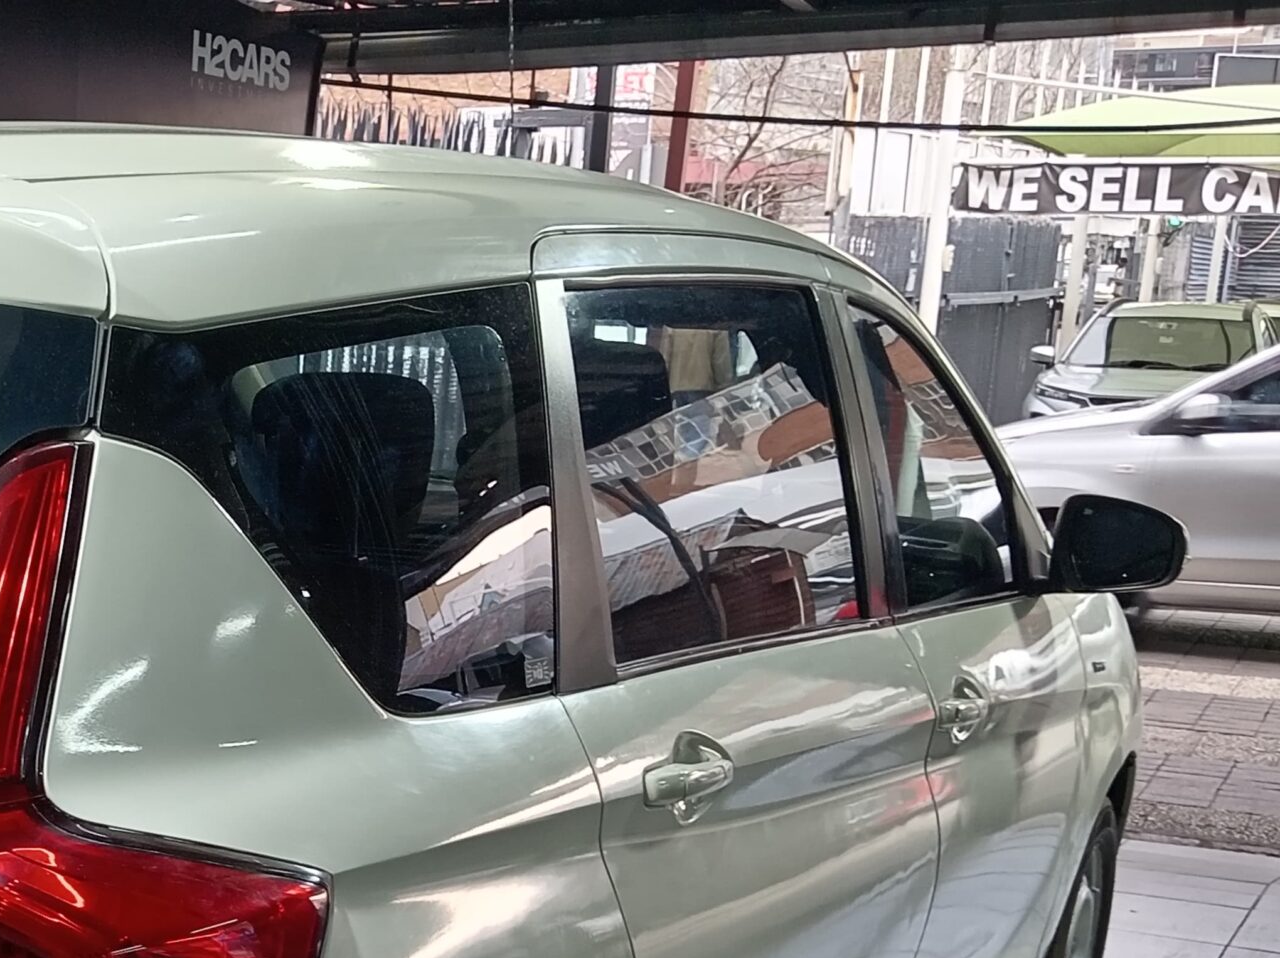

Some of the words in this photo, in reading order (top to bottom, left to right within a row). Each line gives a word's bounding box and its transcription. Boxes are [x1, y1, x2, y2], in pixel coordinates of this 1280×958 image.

[191, 29, 291, 91] H2CARS
[968, 166, 1043, 211] WE
[1055, 166, 1184, 213] SELL
[1201, 167, 1280, 213] CA
